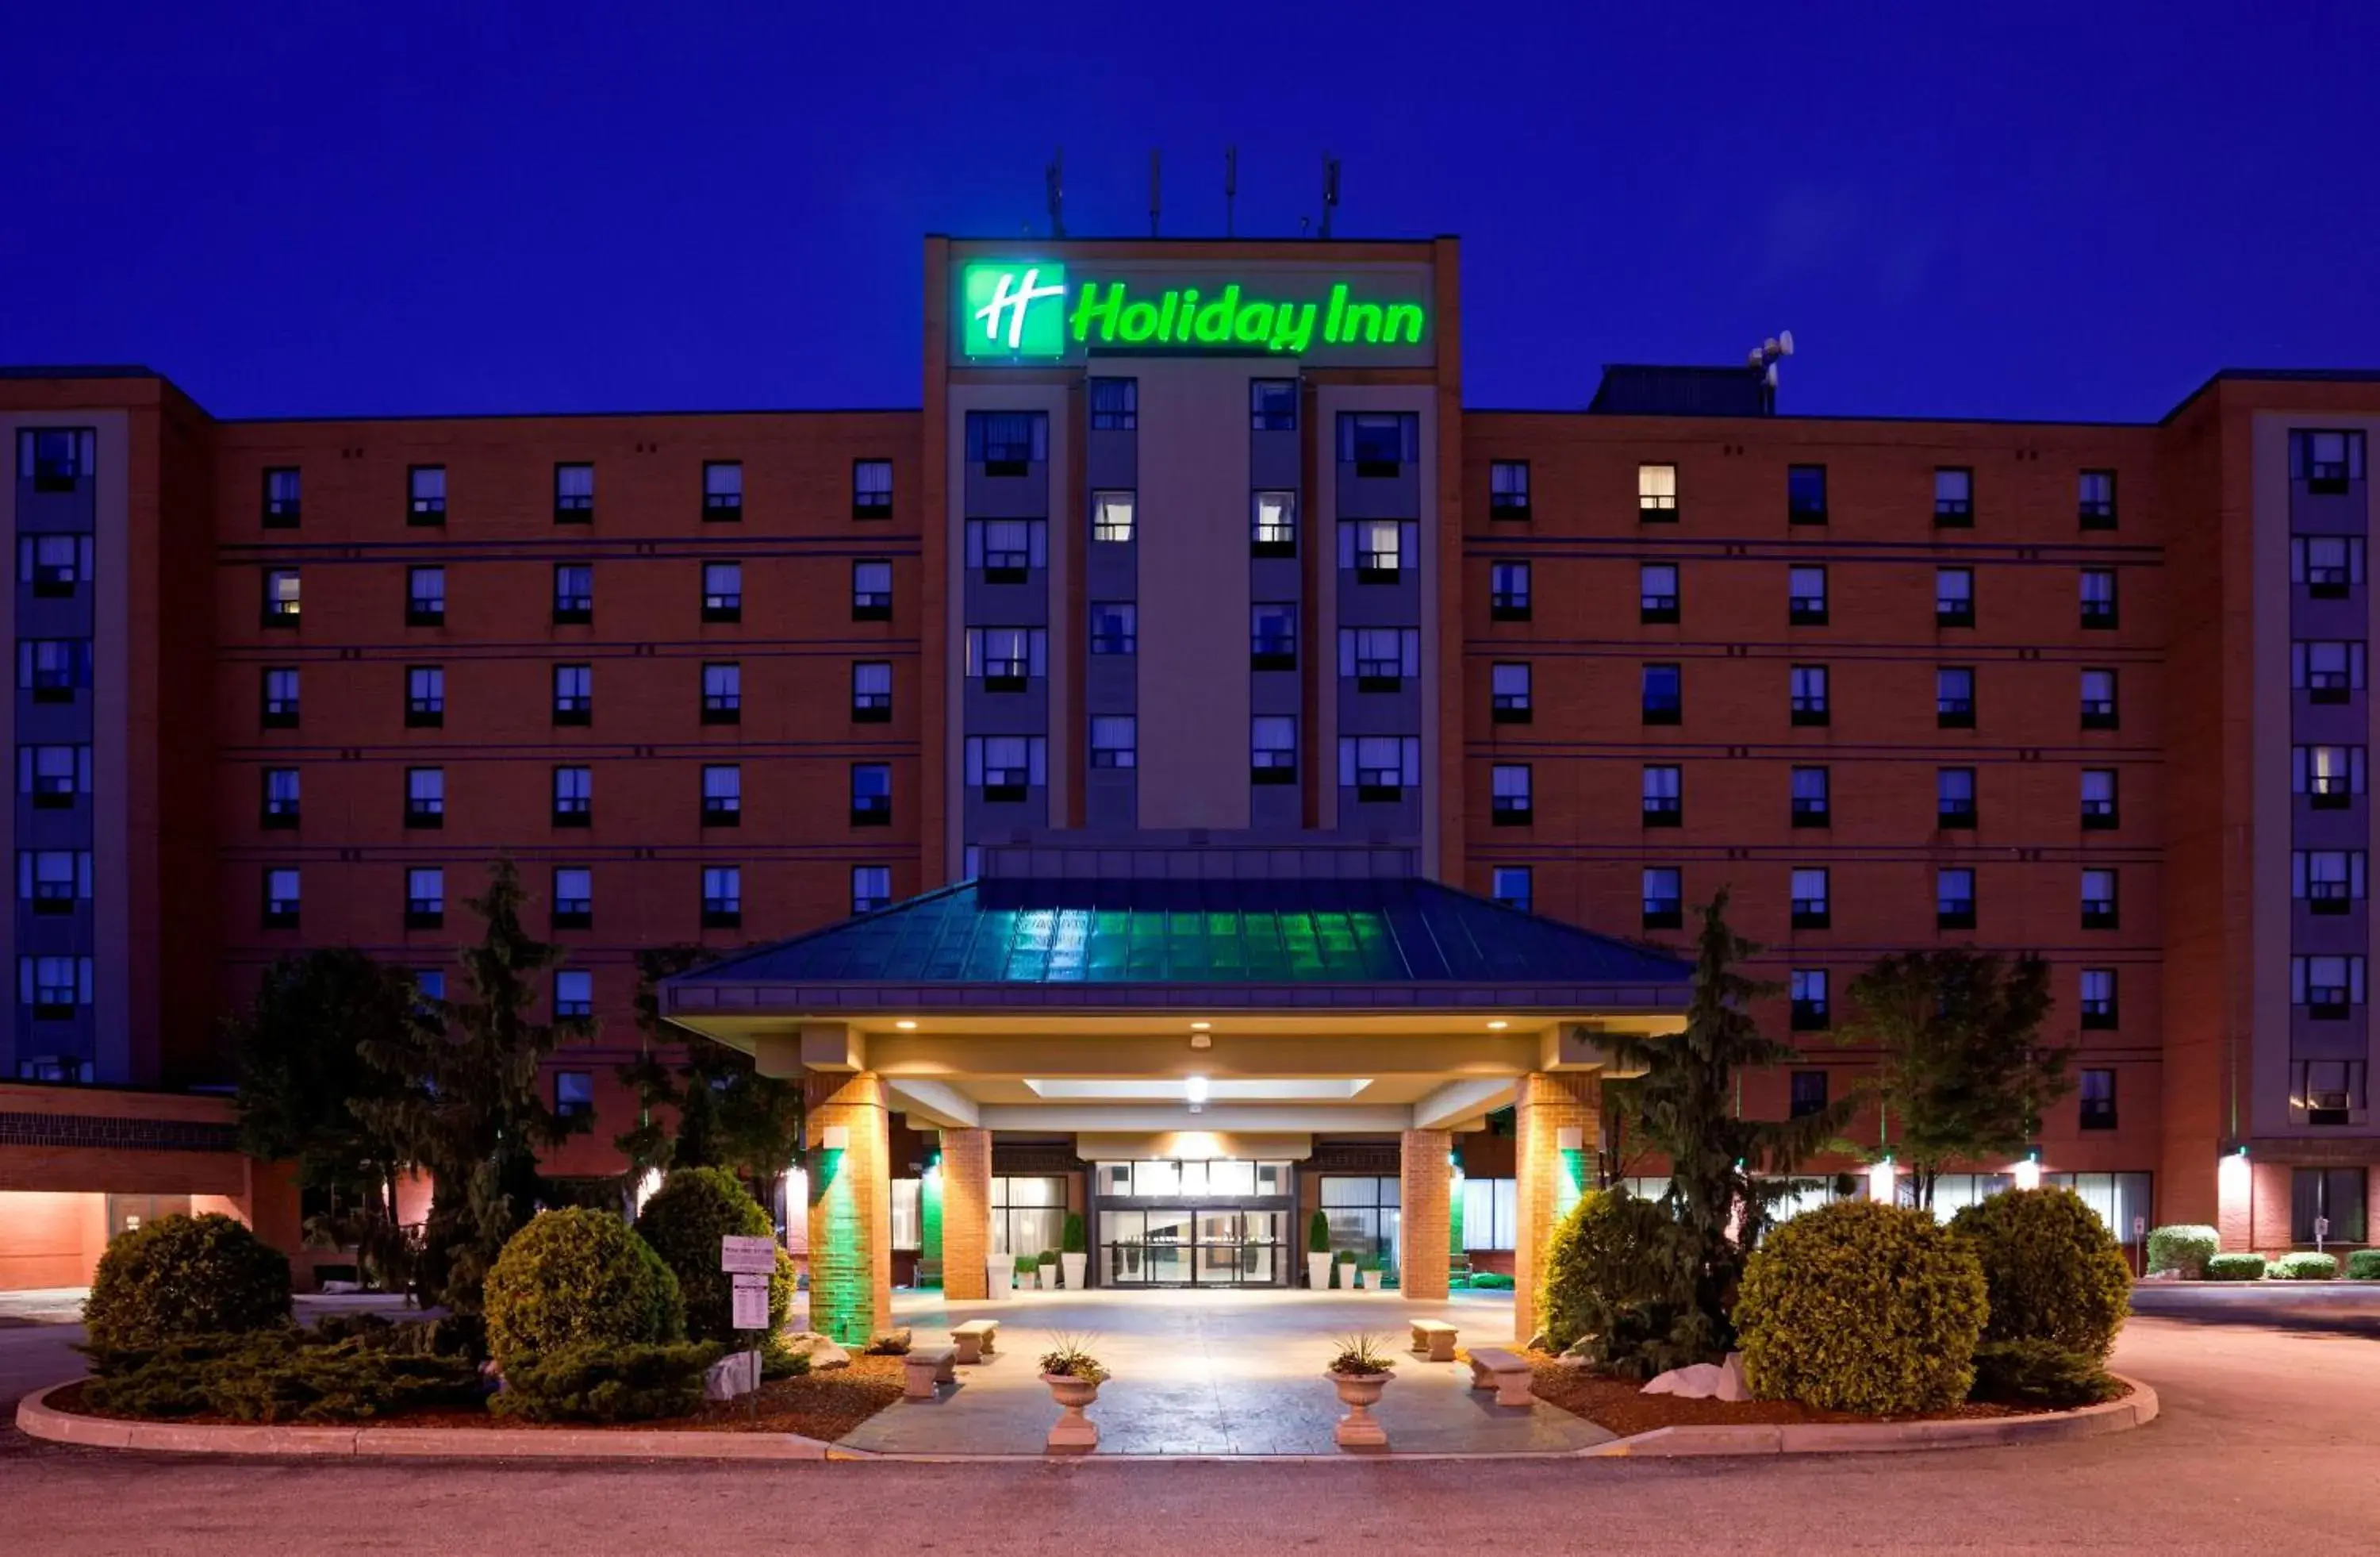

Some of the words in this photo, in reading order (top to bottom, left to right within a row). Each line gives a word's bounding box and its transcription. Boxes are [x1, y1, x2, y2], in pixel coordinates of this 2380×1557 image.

[976, 269, 1064, 348] H
[1070, 283, 1315, 351] Holiday
[1324, 284, 1423, 342] Inn
